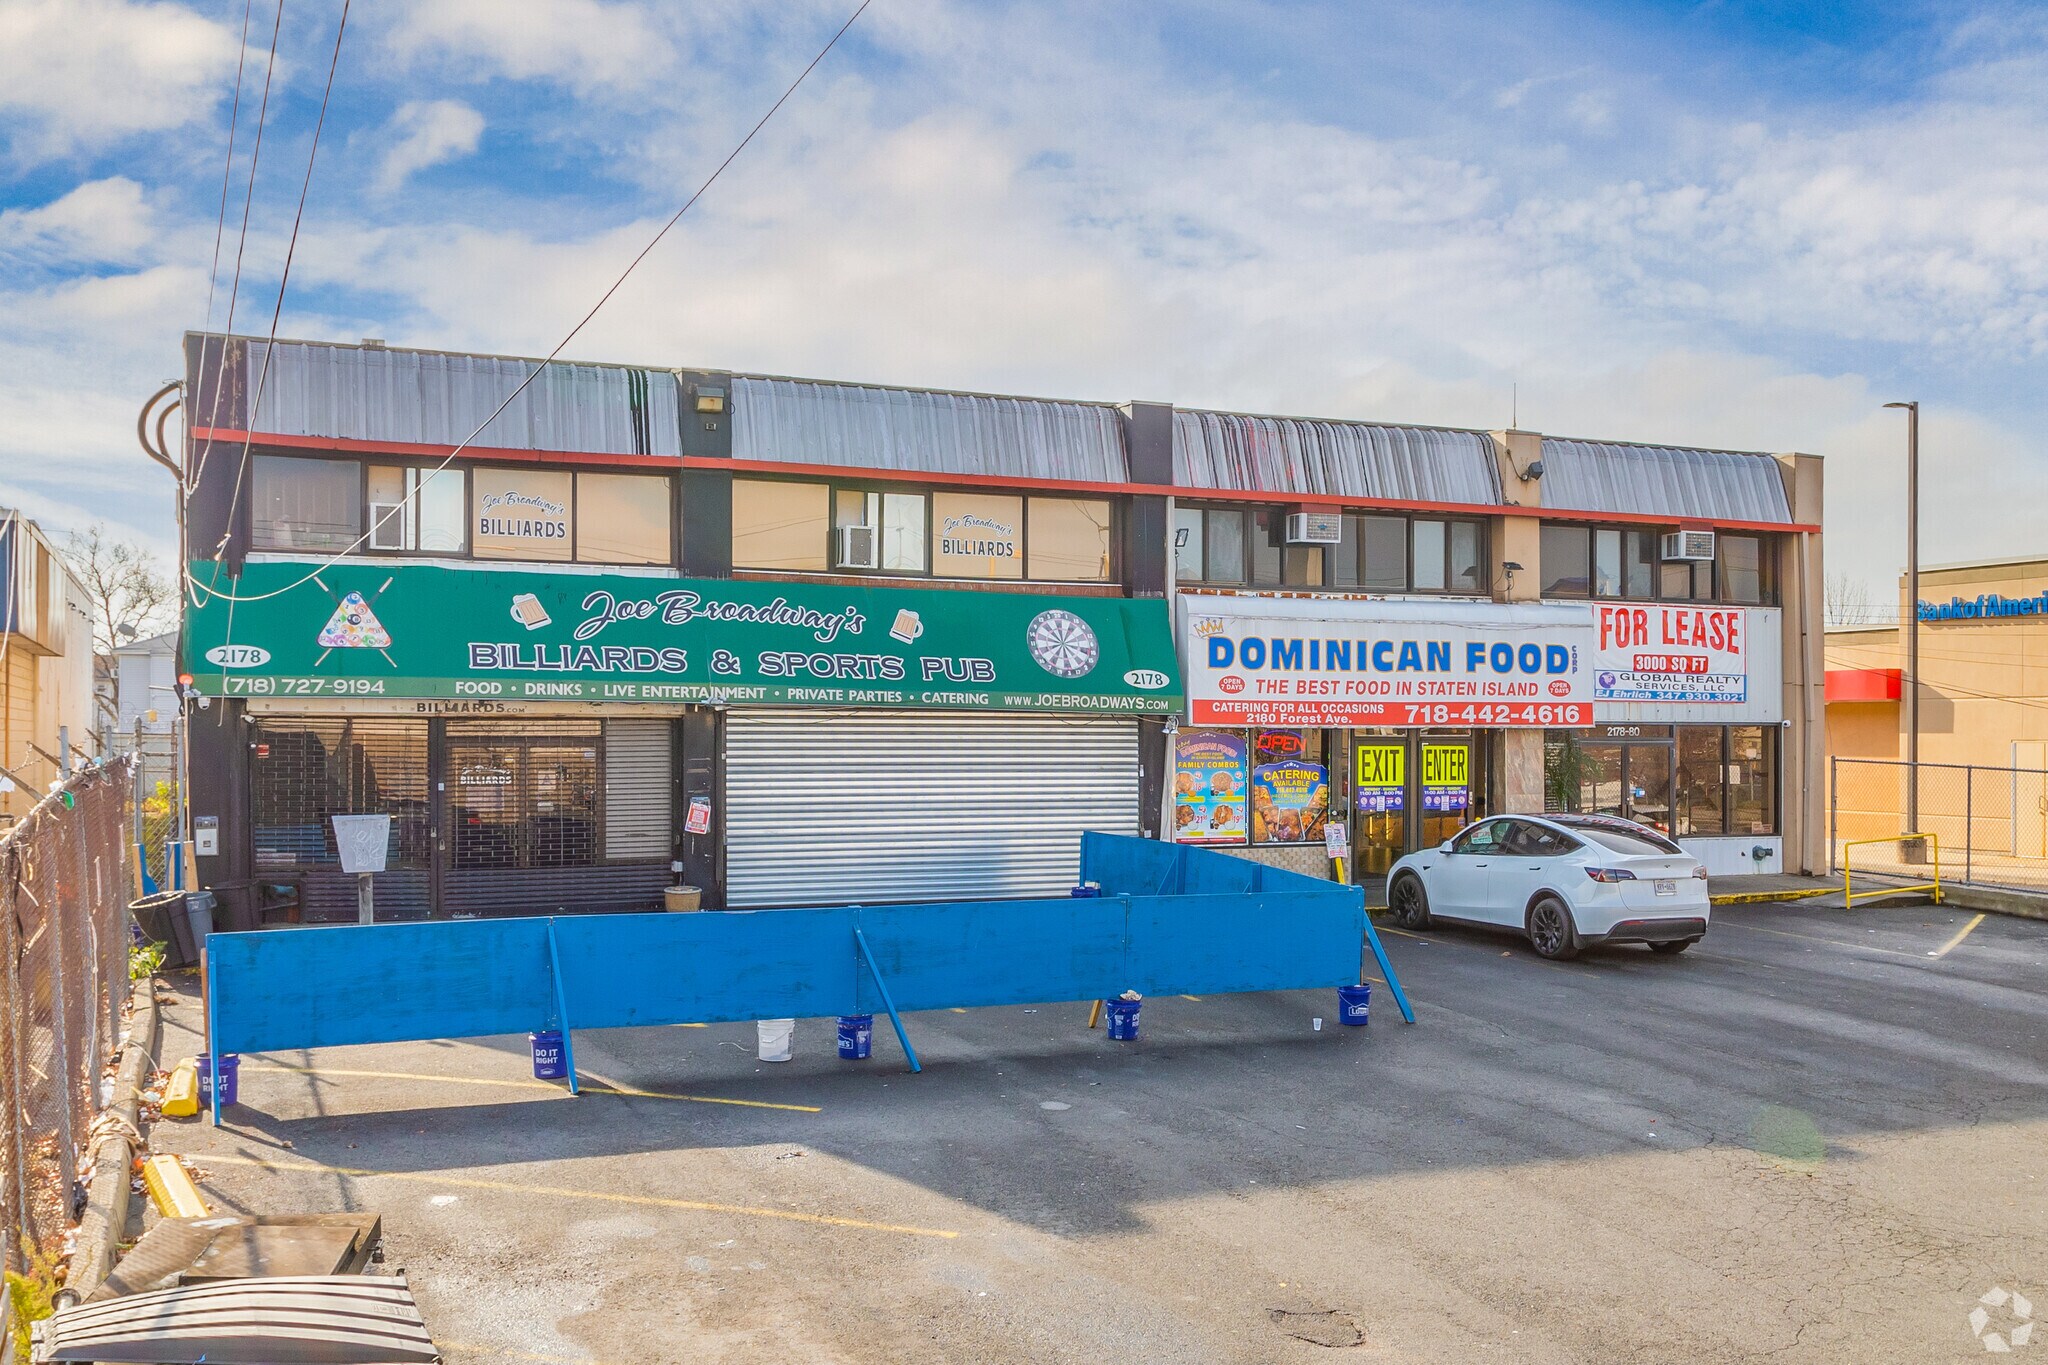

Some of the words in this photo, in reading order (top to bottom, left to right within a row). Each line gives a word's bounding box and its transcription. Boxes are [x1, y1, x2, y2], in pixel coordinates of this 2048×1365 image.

[481, 494, 503, 516] Joe
[504, 491, 564, 515] Broadway's
[480, 518, 565, 538] BILLIARDS
[943, 517, 960, 536] Joe
[962, 514, 1012, 536] Broadway's
[942, 539, 1013, 557] BILLIARDS
[573, 590, 656, 640] Joe
[656, 590, 866, 643] Broadway's
[1917, 596, 1963, 621] Bank
[1600, 607, 1649, 651] FOR
[1662, 609, 1740, 654] LEASE
[217, 649, 261, 663] 2178
[468, 643, 687, 673] BILLIARDS
[711, 649, 741, 675] &
[758, 651, 905, 680] SPORTS
[921, 656, 996, 682] PUB
[1207, 636, 1451, 673] DOMINICAN
[1466, 641, 1569, 675] FOOD
[1636, 656, 1667, 670] 3000
[1671, 657, 1687, 673] SQ
[1691, 658, 1707, 671] FT
[224, 676, 276, 695] (718)
[281, 679, 385, 694] 727-9194
[1131, 673, 1163, 686] 2178
[1619, 673, 1681, 683] GLOBAL
[1686, 675, 1741, 684] REALTY
[1635, 682, 1699, 691] SERVICES,
[1703, 684, 1725, 692] LLC
[455, 681, 502, 695] FOOD
[525, 682, 582, 696] DRINKS
[604, 684, 636, 697] LIVE
[642, 685, 767, 699] ENTERTAINMENT
[787, 688, 844, 701] PRIVATE
[849, 690, 902, 702] PARTIES
[922, 691, 989, 705] CATERING
[1256, 679, 1289, 694] THE
[1296, 680, 1340, 695] BEST
[1345, 680, 1391, 695] FOOD
[1396, 681, 1412, 696] IN
[1417, 681, 1477, 696] STATEN
[1482, 682, 1539, 696] ISLAND
[1595, 690, 1610, 698] EJ
[1612, 690, 1652, 699] Ehrlich
[1656, 692, 1745, 701] 347.930.3021
[1212, 702, 1269, 713] CATERING
[1272, 702, 1295, 713] FOR
[1297, 703, 1318, 713] ALL
[1321, 703, 1384, 714] OCCASIONS
[1404, 704, 1580, 723] 718-442-4616
[1246, 713, 1276, 723] 2180
[1280, 713, 1321, 723] Forest
[1325, 714, 1352, 723] Ave.
[1607, 726, 1640, 737] 2178-80
[1257, 735, 1307, 752] OPEN
[1361, 749, 1400, 781] EXIT
[1426, 749, 1465, 781] ENTER
[460, 775, 512, 785] BILLIARDS
[1263, 769, 1320, 782] CATERING
[535, 1049, 547, 1057] DO
[549, 1048, 558, 1057] IT
[203, 1084, 229, 1092] RIHT
